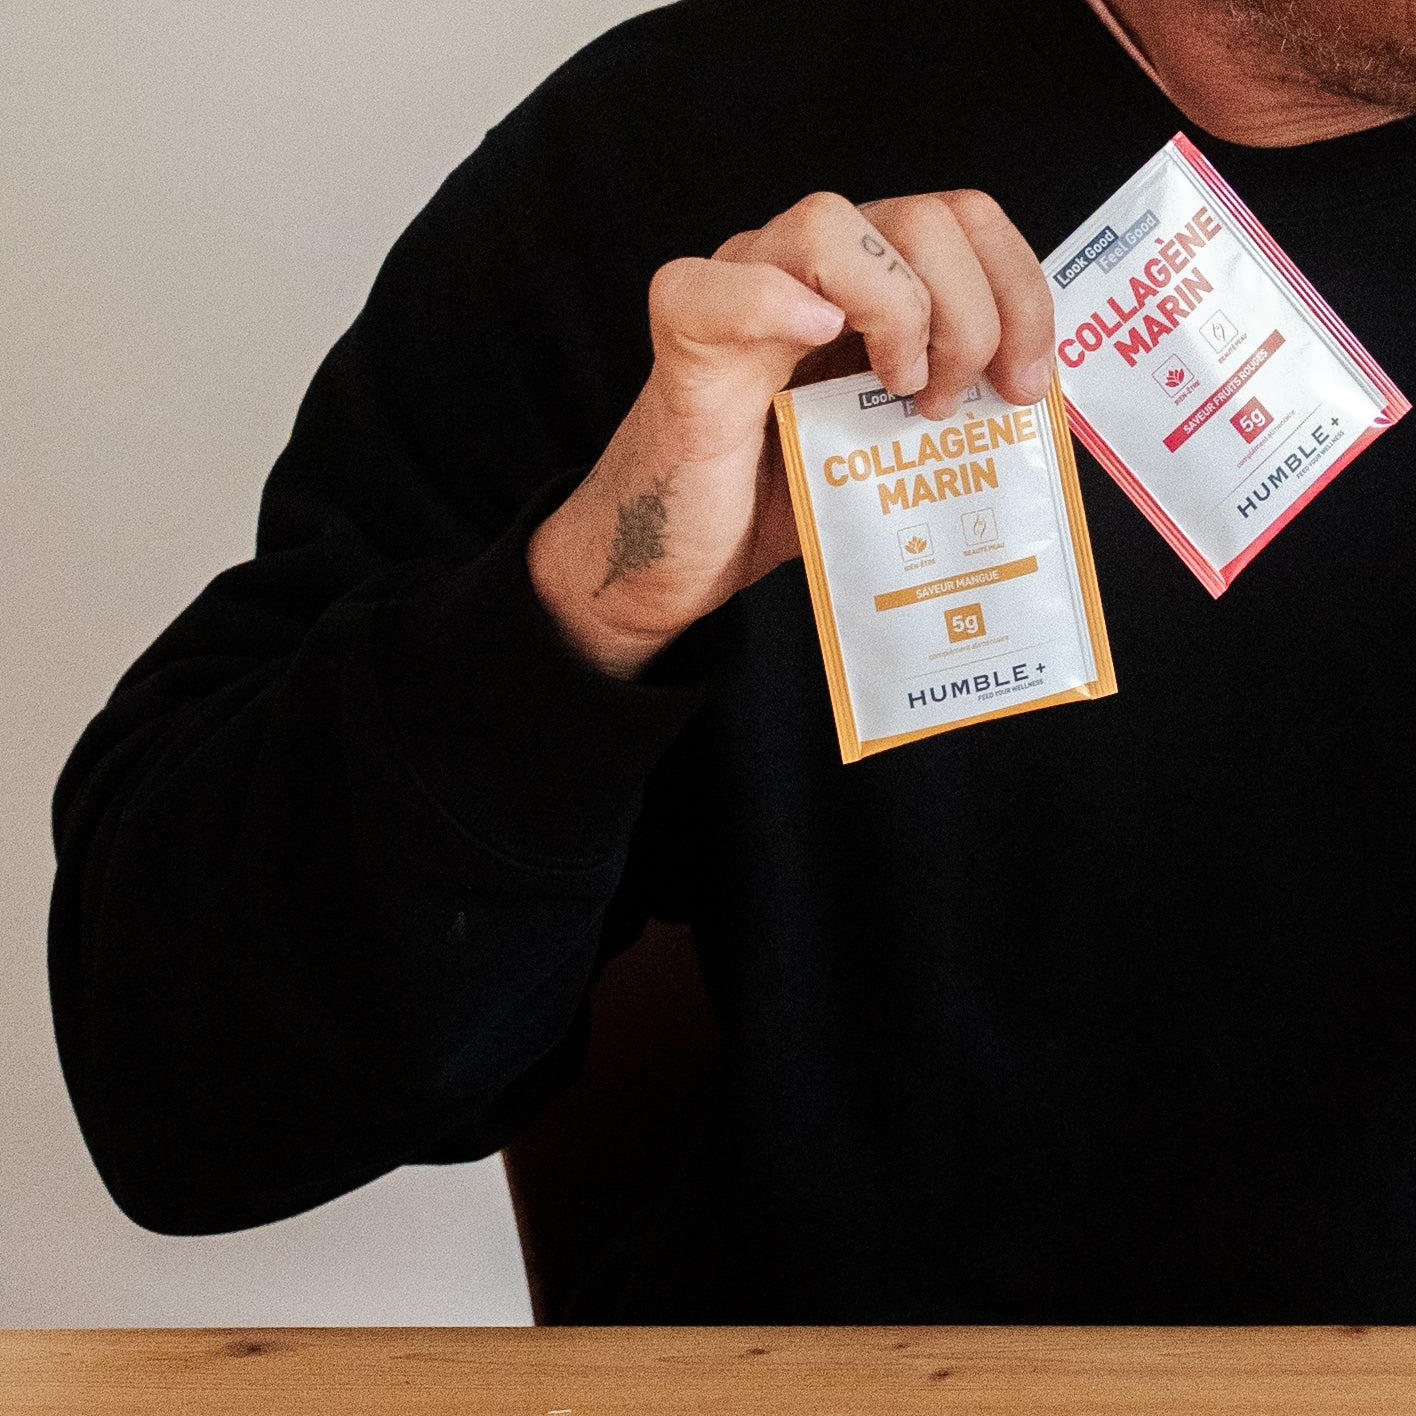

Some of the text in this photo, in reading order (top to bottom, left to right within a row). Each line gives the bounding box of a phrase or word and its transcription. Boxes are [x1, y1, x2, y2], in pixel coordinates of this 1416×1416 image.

[1056, 230, 1116, 285] Look Good
[1099, 214, 1157, 270] Feel Good
[1058, 205, 1223, 368] COLLAGÈNE
[1113, 267, 1214, 368] MARIN
[1183, 349, 1268, 434] SAVEUR FRUITS ROUGES
[823, 408, 1037, 488] COLLAGÈNE
[1240, 408, 1266, 433] 5g
[877, 457, 999, 515] MARIN
[915, 570, 1000, 599] SAVEUR MANGUE
[952, 615, 979, 634] 5g
